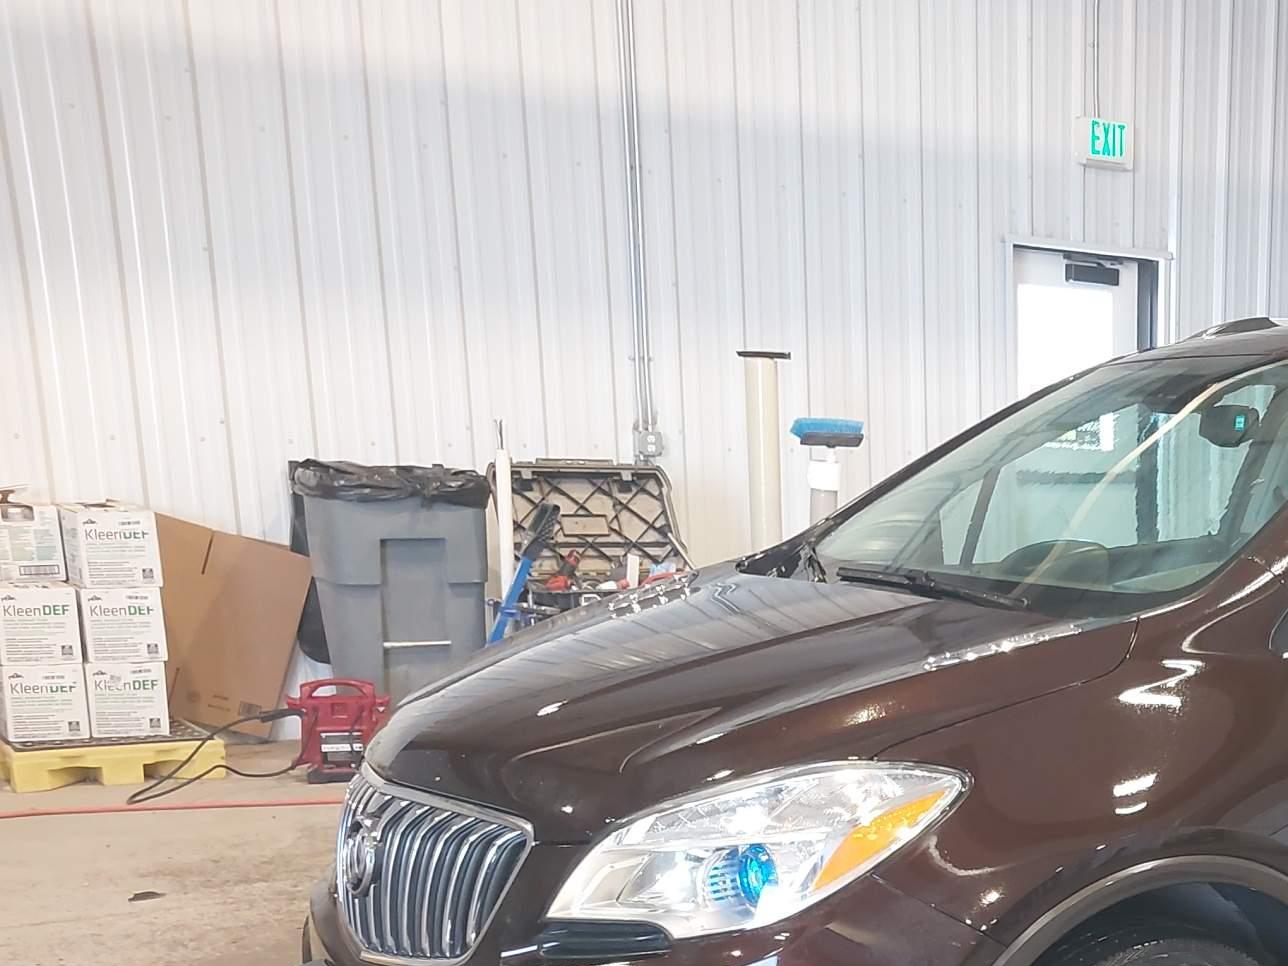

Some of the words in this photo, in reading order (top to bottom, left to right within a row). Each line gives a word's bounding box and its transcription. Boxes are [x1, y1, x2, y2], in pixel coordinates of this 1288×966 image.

[1091, 119, 1127, 157] EXIT
[2, 604, 70, 617] KleenDEF
[89, 604, 155, 617] KleenDEF
